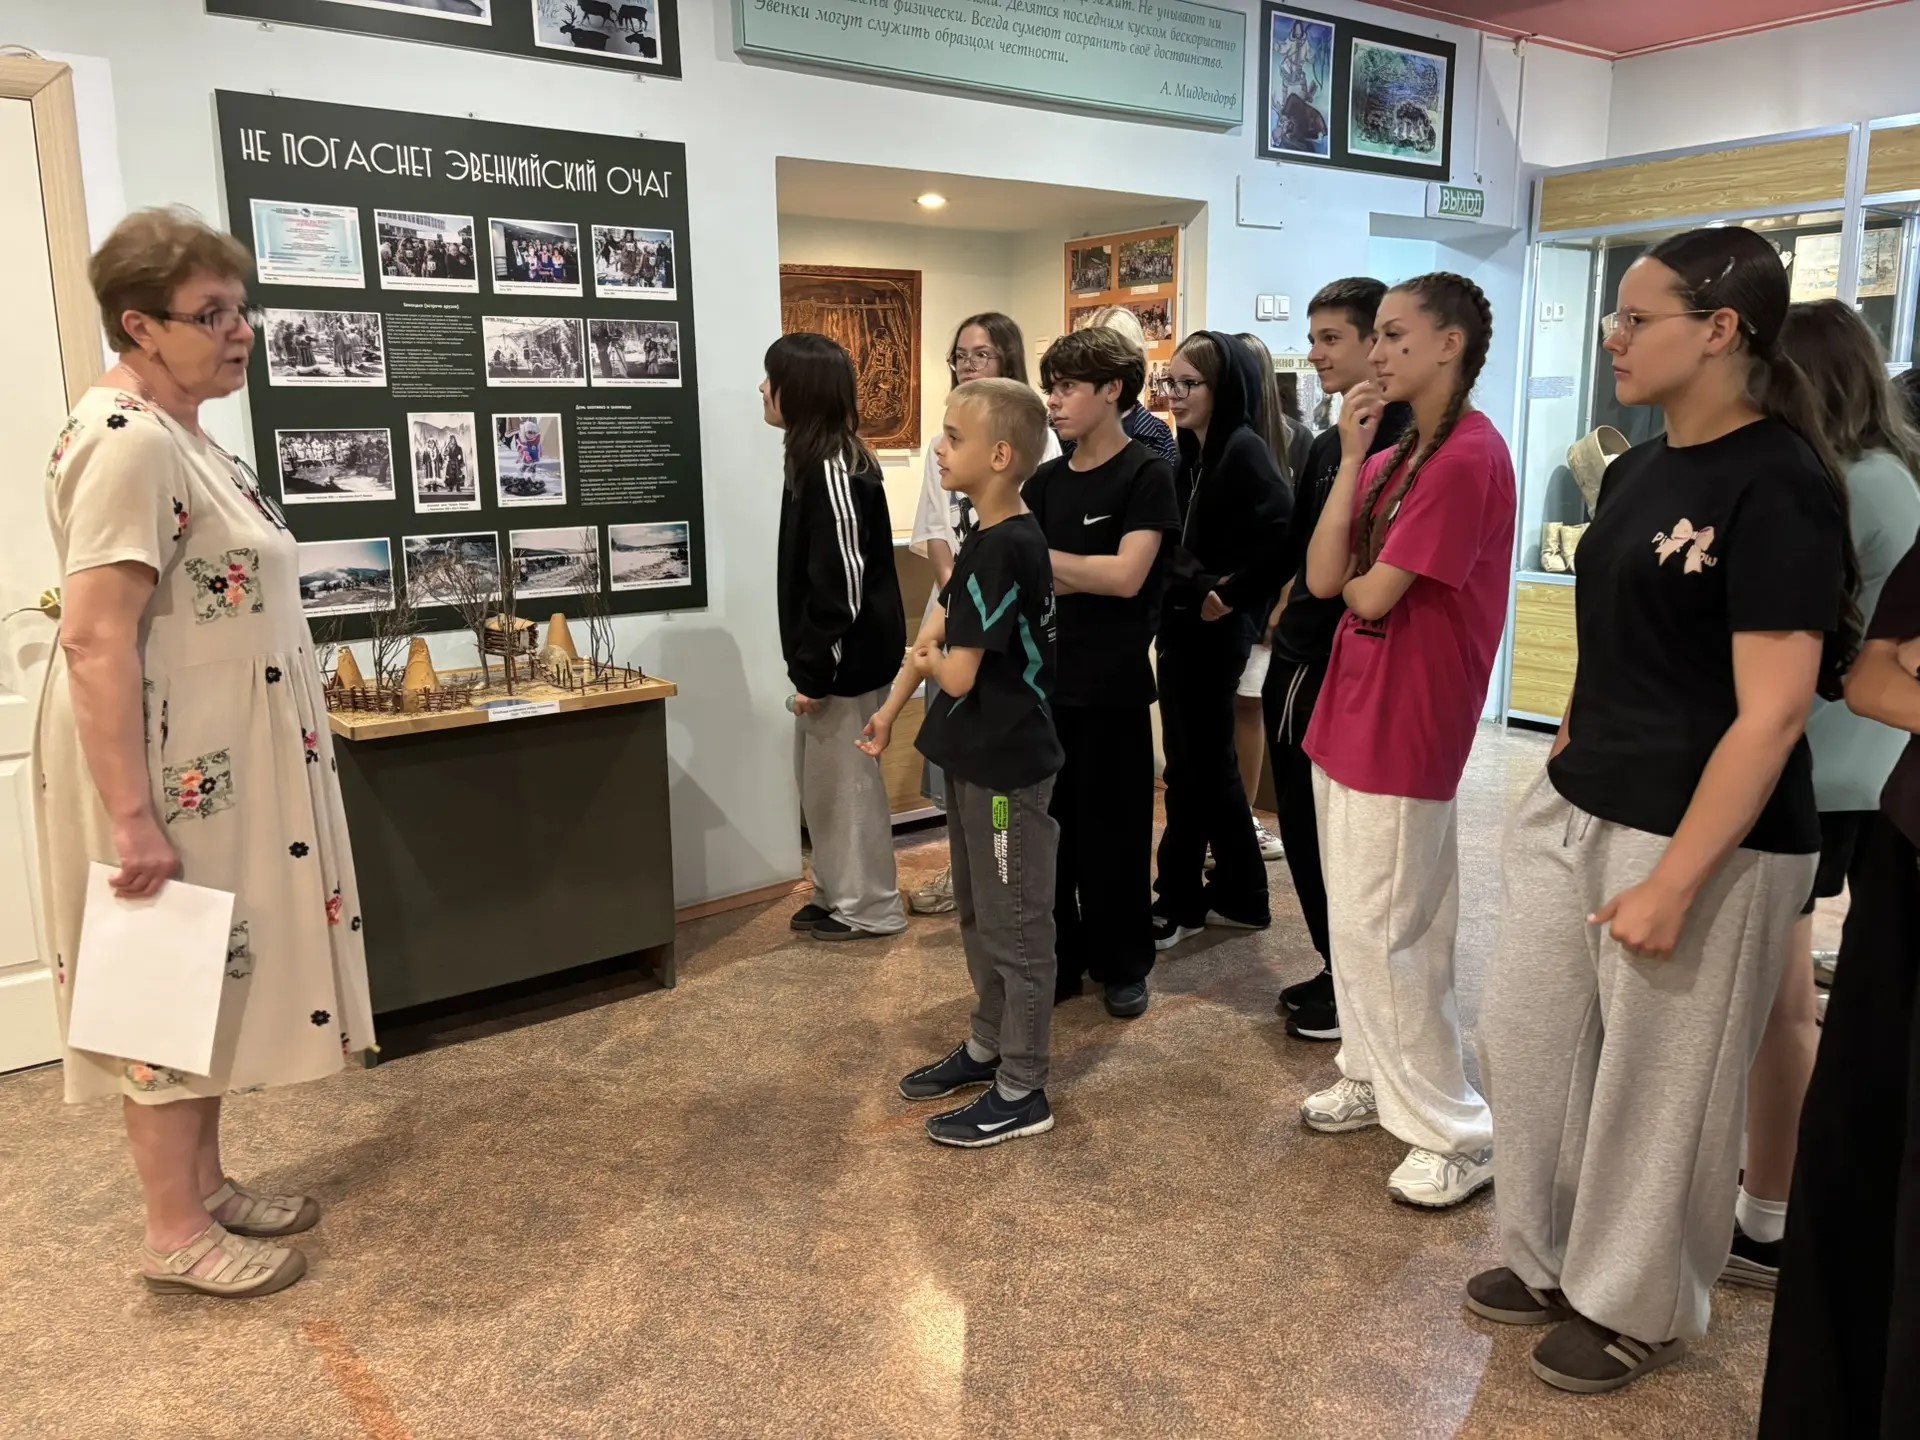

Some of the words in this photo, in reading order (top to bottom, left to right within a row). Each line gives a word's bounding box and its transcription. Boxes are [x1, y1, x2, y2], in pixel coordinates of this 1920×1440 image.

[754, 0, 810, 19] Эвенки
[815, 9, 864, 31] могут
[867, 17, 930, 40] служить
[935, 27, 995, 52] образцом
[999, 41, 1069, 63] честности.
[893, 0, 967, 23] физически.
[971, 10, 1009, 32] Всегда
[1012, 21, 1062, 40] сумеют
[1065, 31, 1127, 53] сохранить
[1129, 43, 1151, 57] своё
[1154, 43, 1224, 69] достоинство.
[1005, 0, 1059, 18] Делятся
[1063, 9, 1124, 31] последним
[1127, 22, 1167, 40] куском
[1170, 26, 1237, 53] бескорыстно
[1138, 0, 1154, 15] Не
[1208, 16, 1223, 31] ни
[1160, 80, 1172, 97] А.
[1174, 82, 1238, 110] Миддендорф
[239, 127, 272, 163] НЕ
[281, 132, 433, 178] ПОГАСНЕТ
[444, 149, 598, 193] ЭВЕНКИЙСКИЙ
[606, 166, 673, 199] ОЧАГ
[1442, 188, 1482, 215] ВЫХОД
[1272, 358, 1294, 368] ЖНО
